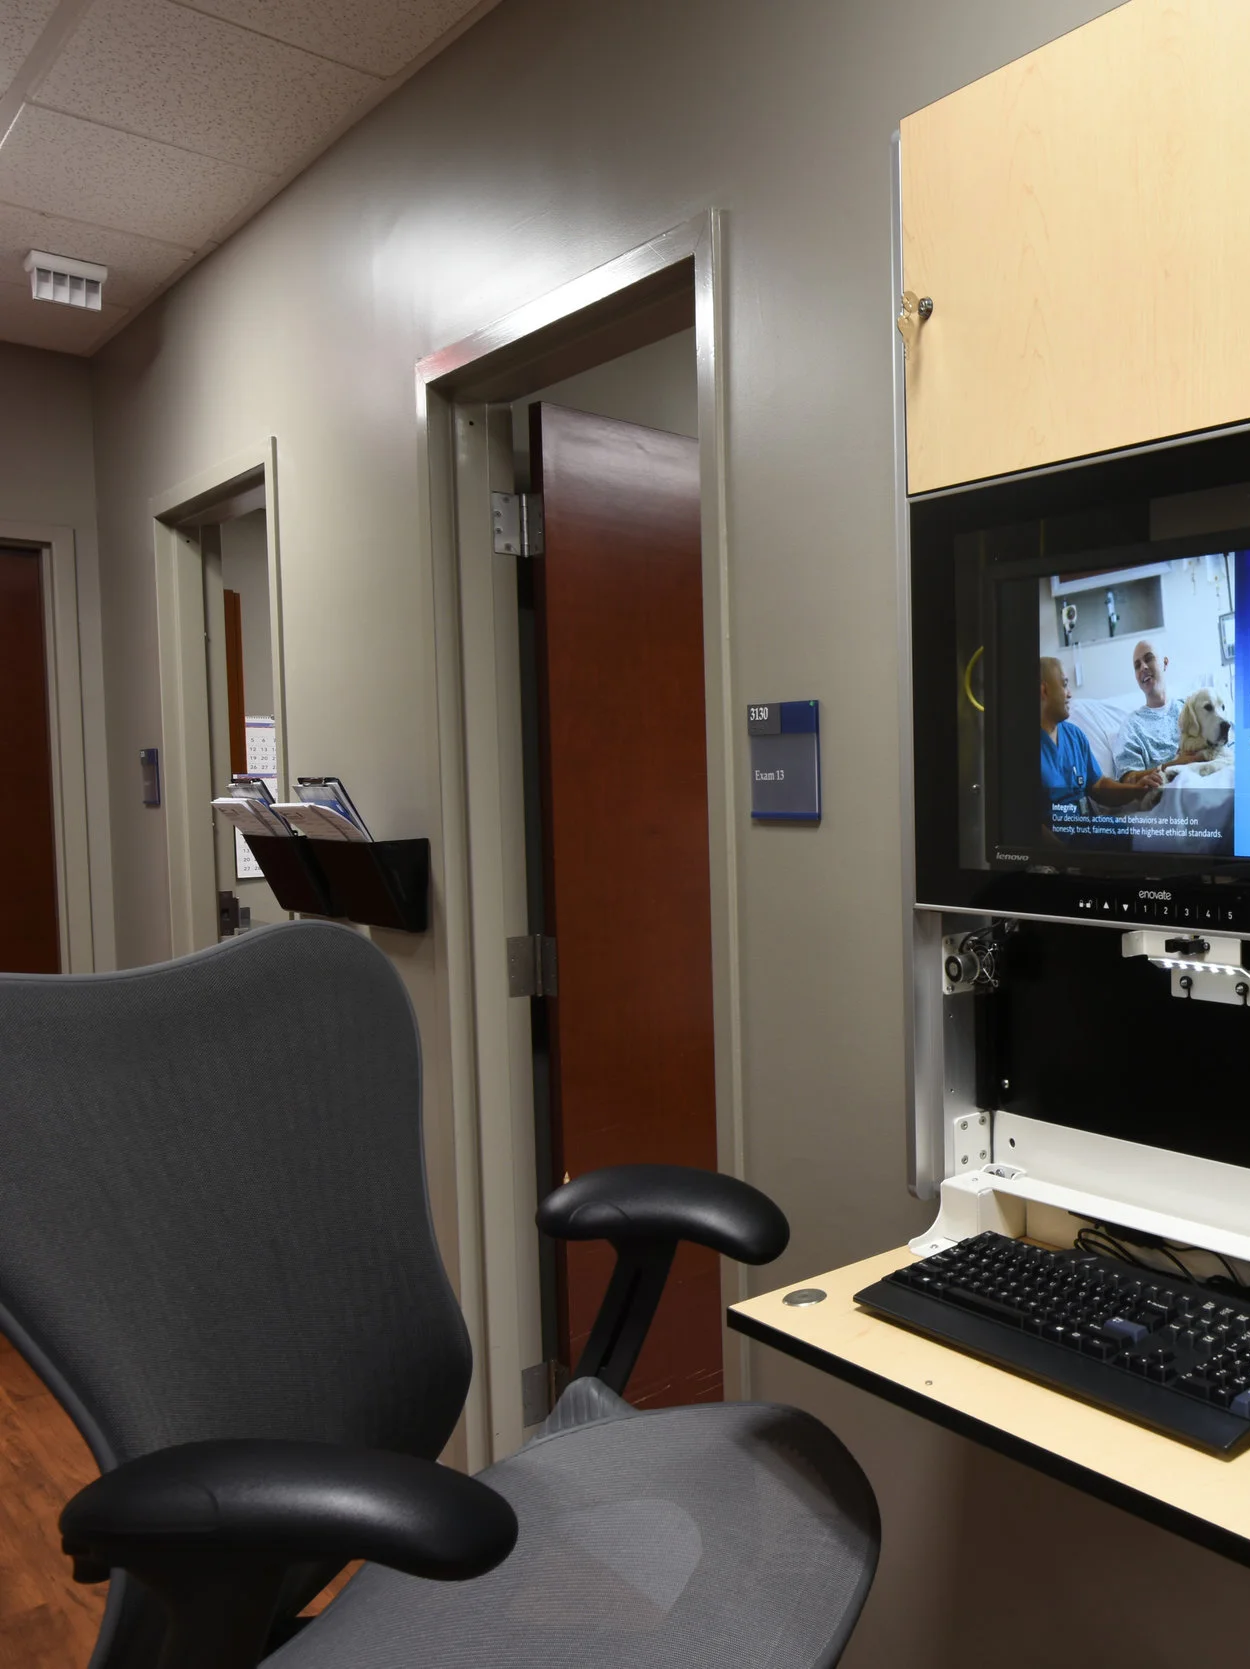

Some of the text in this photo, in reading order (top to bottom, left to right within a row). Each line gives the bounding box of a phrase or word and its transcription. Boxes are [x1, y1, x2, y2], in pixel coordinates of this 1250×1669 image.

[750, 707, 768, 721] 3130
[755, 770, 785, 780] Exam 13
[1052, 803, 1077, 812] Integrity
[1064, 815, 1090, 823] decisions,
[1092, 815, 1114, 824] actions,
[1128, 816, 1157, 824] behaviors
[1170, 817, 1188, 825] based
[1052, 826, 1222, 838] honesty, trust, fairness, and the highest ethical standards.
[996, 852, 1028, 861] lenovo
[1139, 890, 1172, 900] enovate
[1163, 907, 1168, 915] 2
[1185, 908, 1189, 916] 3
[1206, 910, 1211, 918] 4
[1228, 912, 1233, 920] 5
